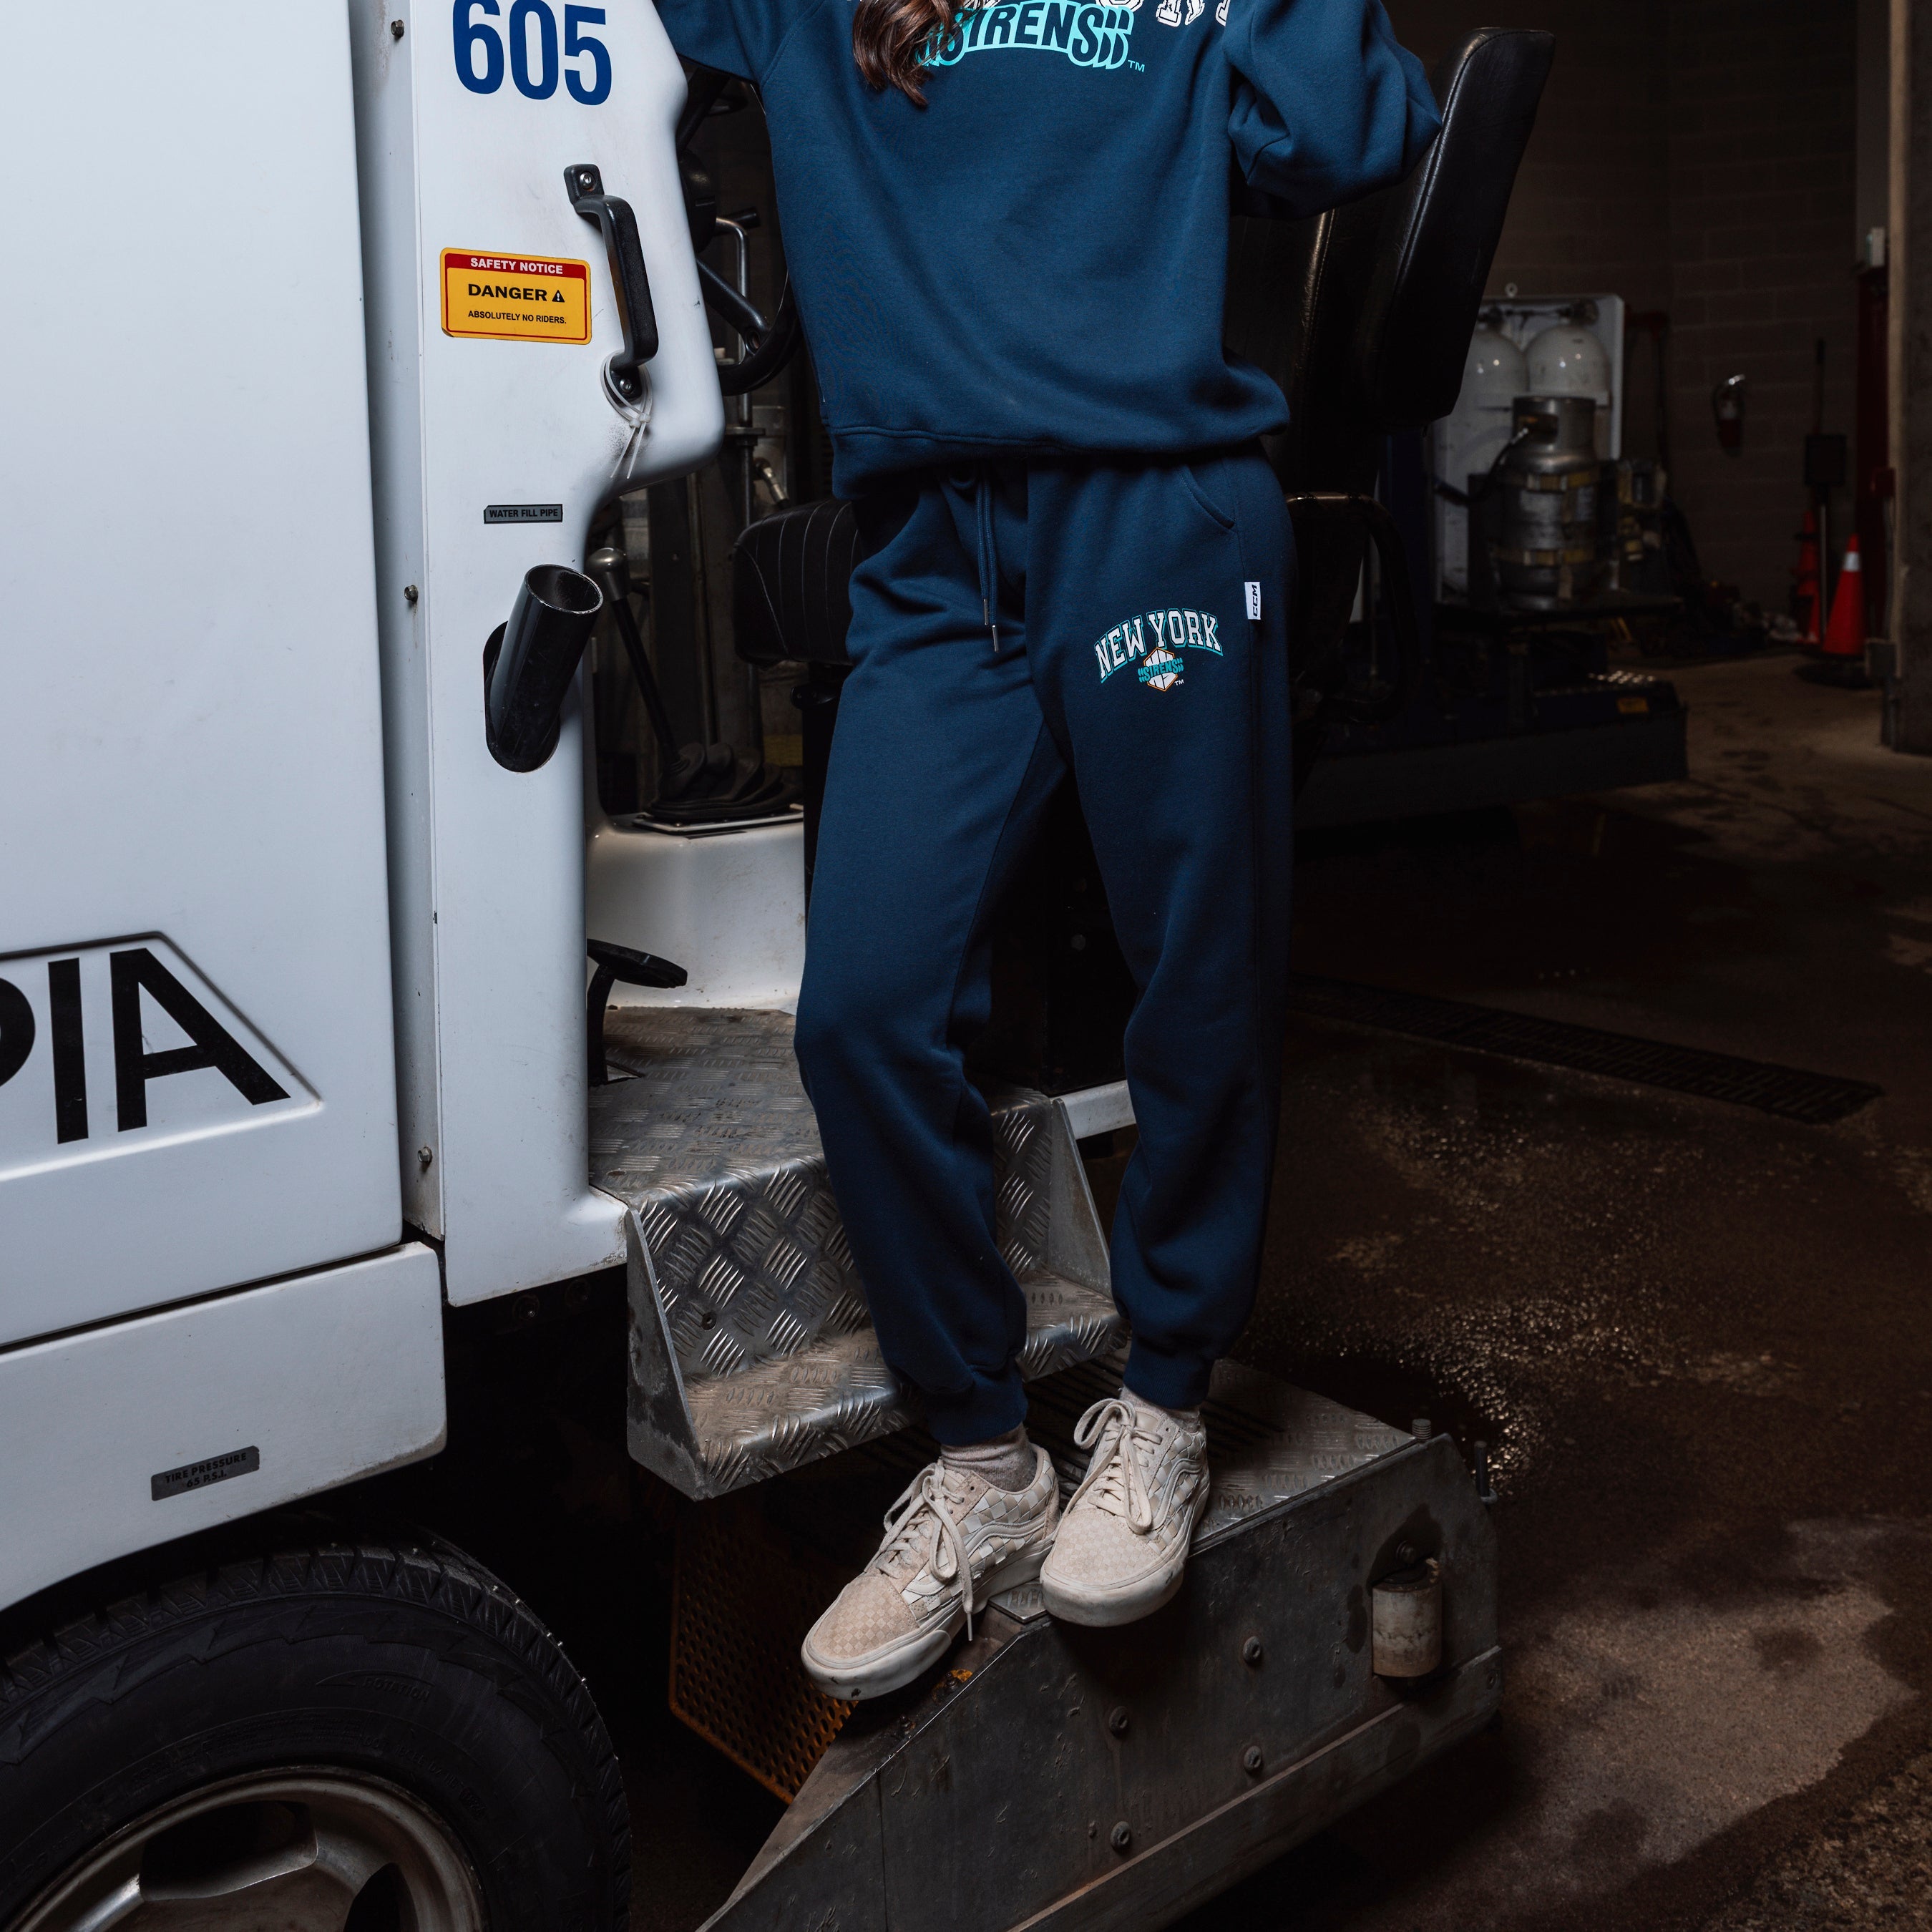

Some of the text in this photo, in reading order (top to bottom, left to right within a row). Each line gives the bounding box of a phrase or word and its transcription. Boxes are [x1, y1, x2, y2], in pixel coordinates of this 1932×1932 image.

[453, 0, 612, 106] 605
[1128, 60, 1146, 72] TM
[470, 258, 563, 275] SAFETY NOTICE
[468, 283, 547, 301] DANGER
[468, 311, 521, 321] ABSOLUTELY
[536, 315, 567, 324] RIDERS.
[521, 509, 537, 517] FILL
[1094, 608, 1224, 683] NEW YORK
[1138, 658, 1184, 683] SIRENS
[165, 1453, 247, 1483] TIRE PRESSURE
[187, 1477, 200, 1488] 65
[361, 1676, 431, 1702] ROTATION
